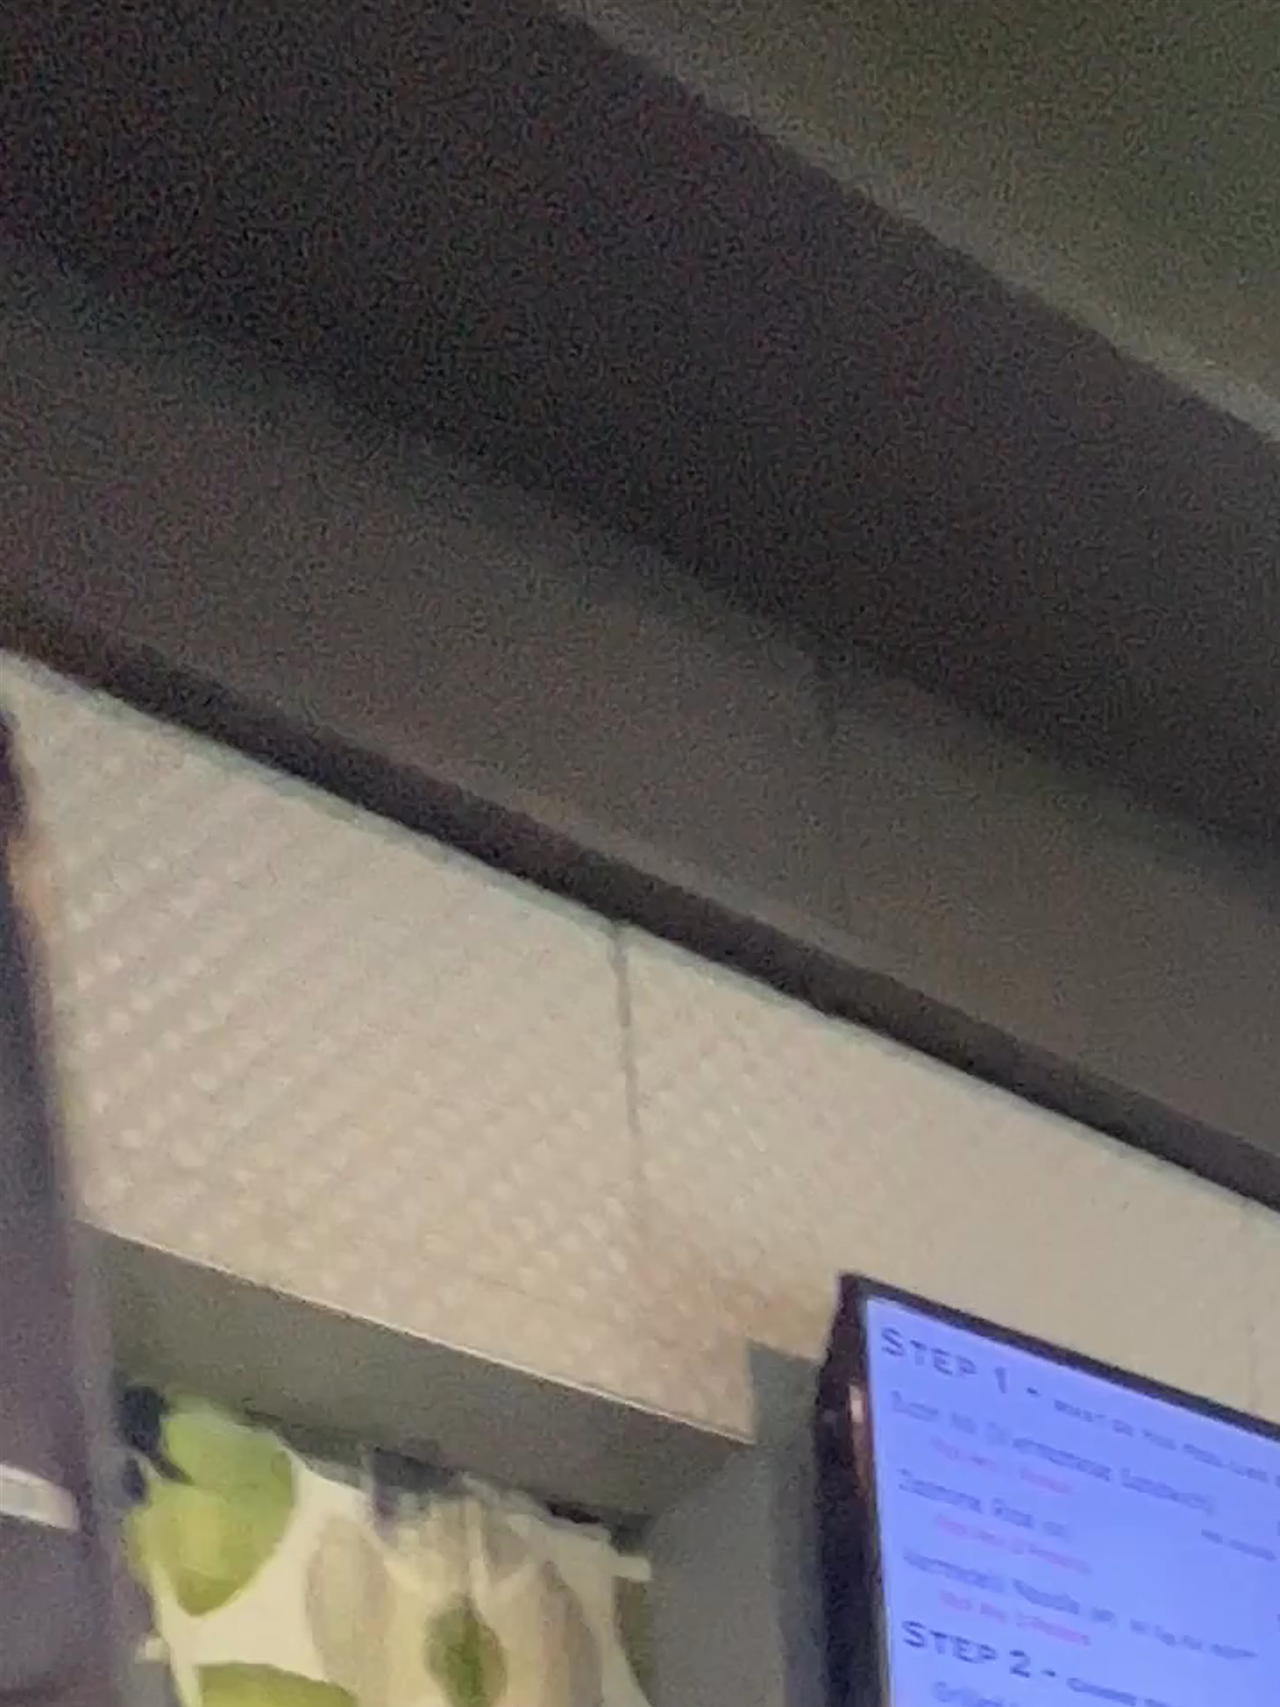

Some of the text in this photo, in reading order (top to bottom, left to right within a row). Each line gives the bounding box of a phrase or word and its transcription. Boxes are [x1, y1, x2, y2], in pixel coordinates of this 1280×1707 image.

[880, 1327, 978, 1377] STEP
[993, 1365, 1008, 1395] 1
[902, 1619, 998, 1664] STEP
[1008, 1649, 1032, 1679] 2
